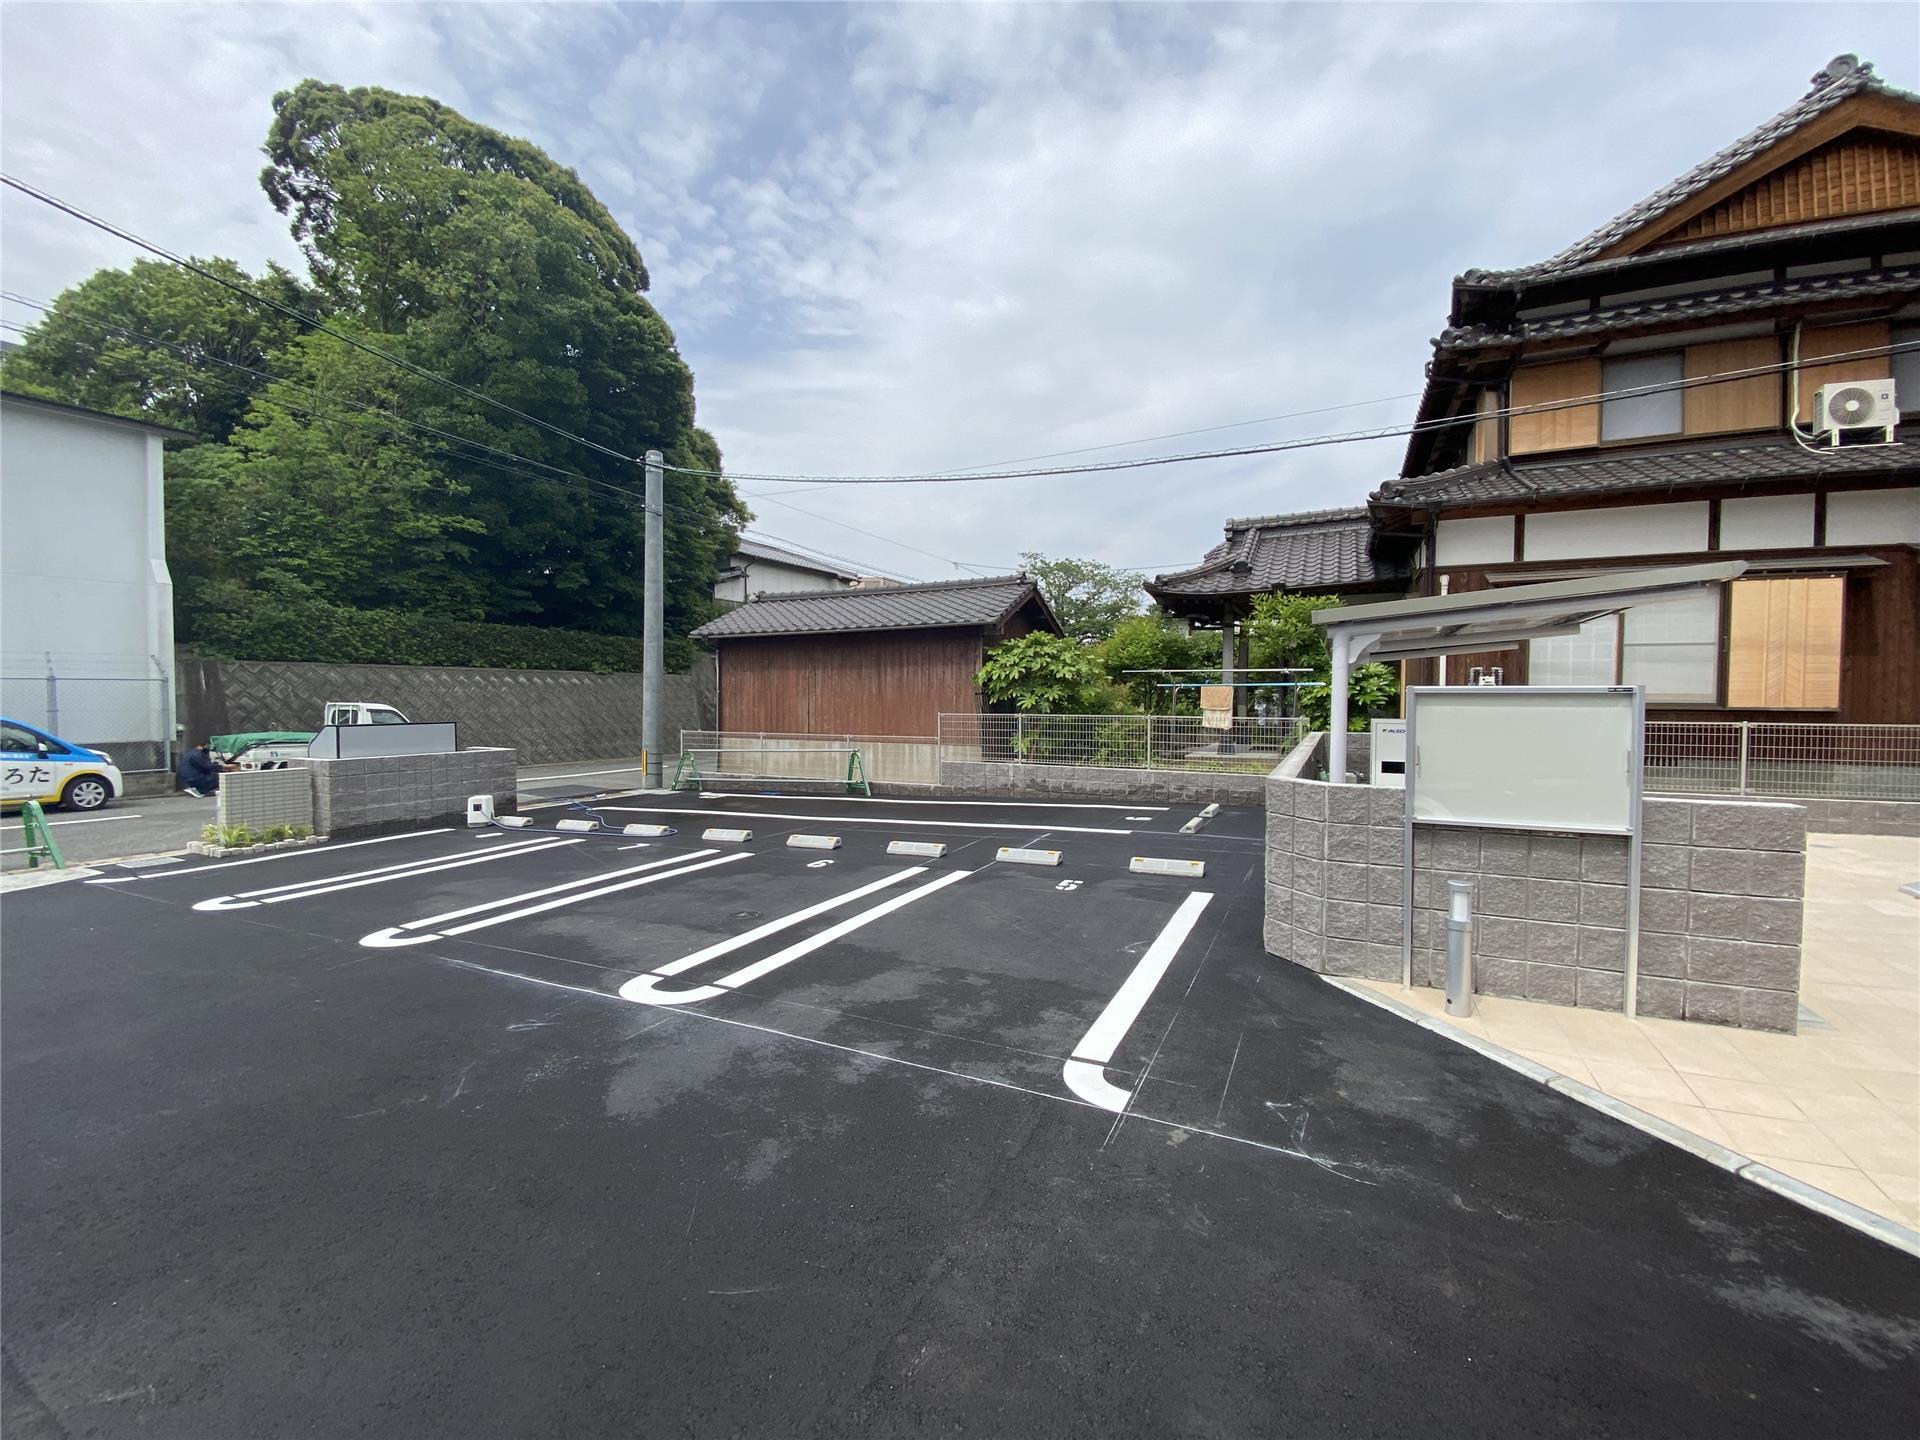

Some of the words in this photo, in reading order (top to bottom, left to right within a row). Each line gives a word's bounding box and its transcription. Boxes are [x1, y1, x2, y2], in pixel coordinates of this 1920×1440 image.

[4, 766, 50, 785] ろた
[806, 859, 835, 868] 6
[1055, 879, 1084, 891] 5
